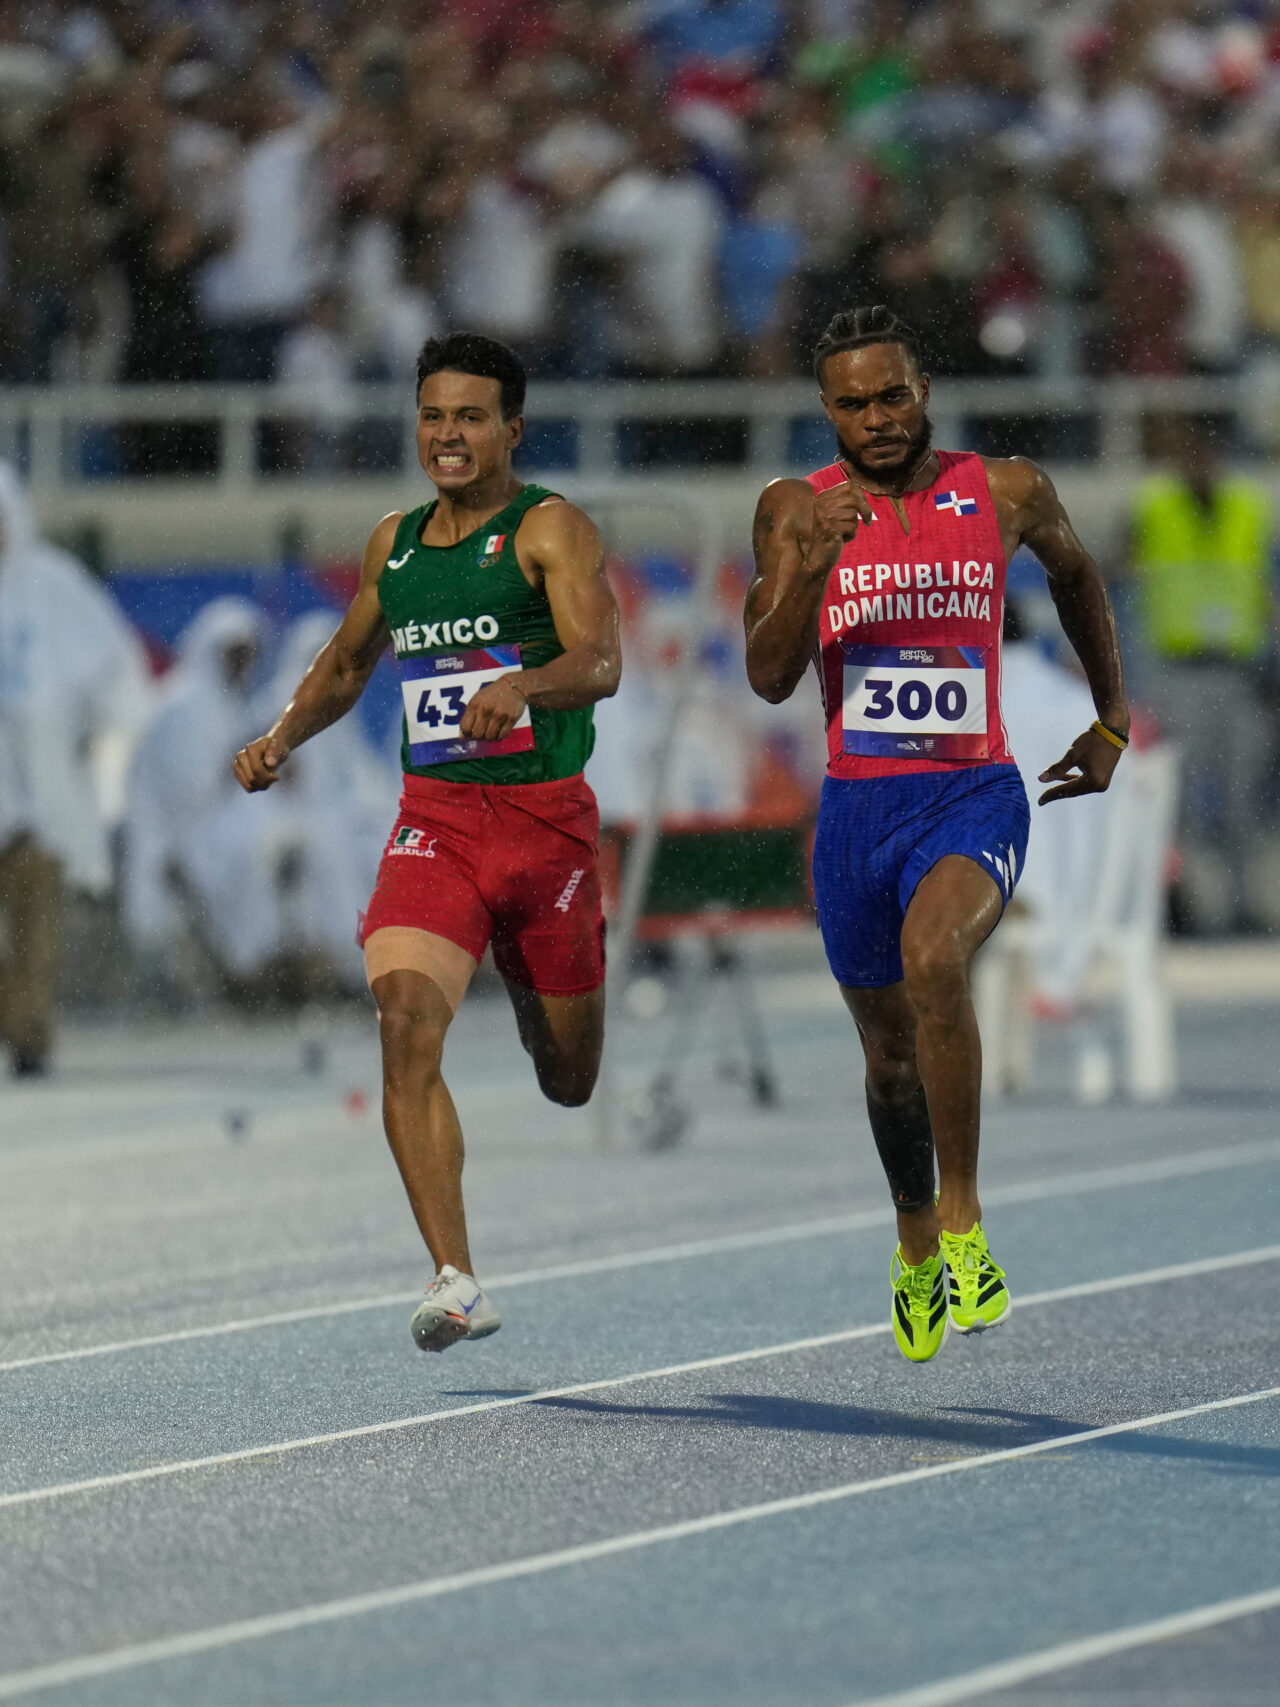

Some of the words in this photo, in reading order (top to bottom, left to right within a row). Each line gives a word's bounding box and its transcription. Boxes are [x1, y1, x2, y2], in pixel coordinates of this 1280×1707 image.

[838, 560, 994, 595] REPUBLICA
[828, 591, 991, 633] DOMINICANA
[390, 615, 499, 654] MÉXICO
[417, 681, 494, 728] 43
[863, 679, 967, 721] 300
[554, 869, 584, 912] Joma
